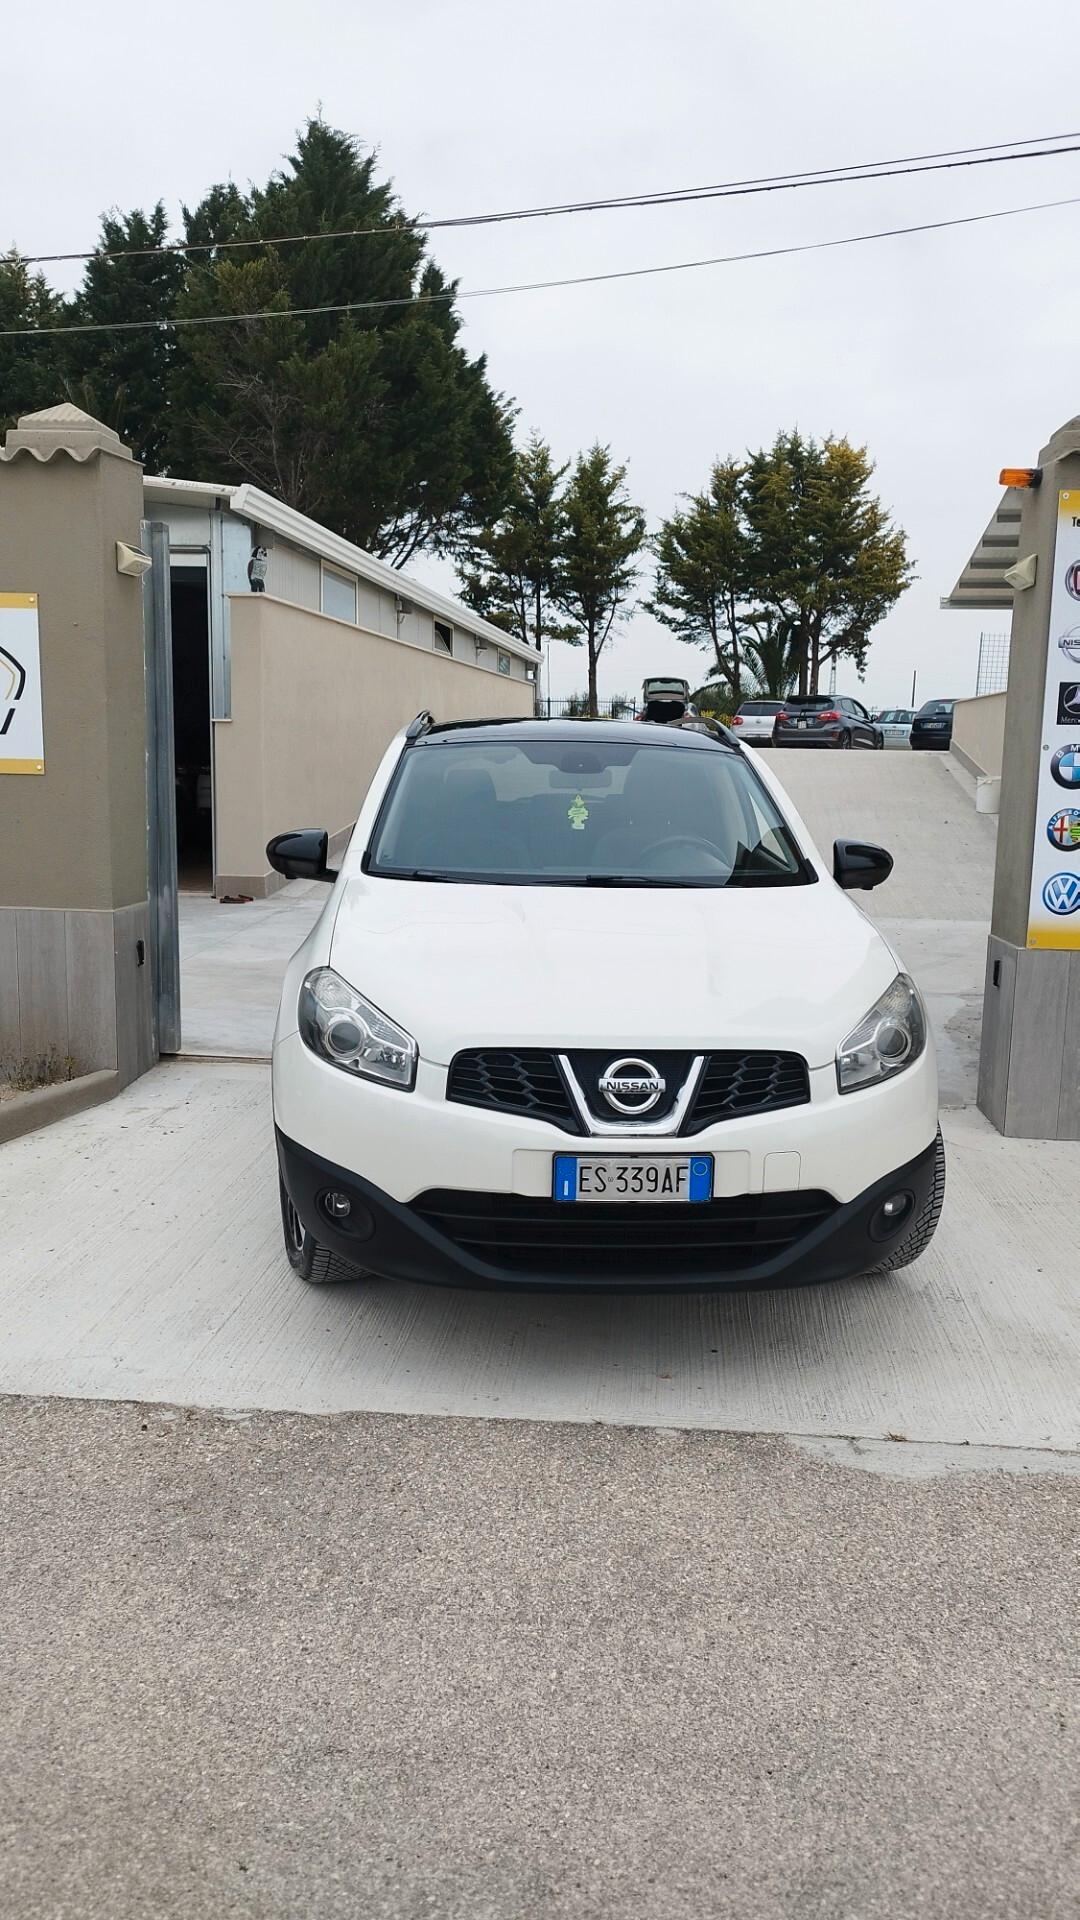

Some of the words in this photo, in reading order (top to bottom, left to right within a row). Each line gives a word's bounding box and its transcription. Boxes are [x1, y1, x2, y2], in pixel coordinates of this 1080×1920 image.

[1056, 744, 1080, 758] BM
[606, 1081, 659, 1091] NISSAN
[579, 1166, 607, 1193] ES
[616, 1166, 689, 1193] 339AF
